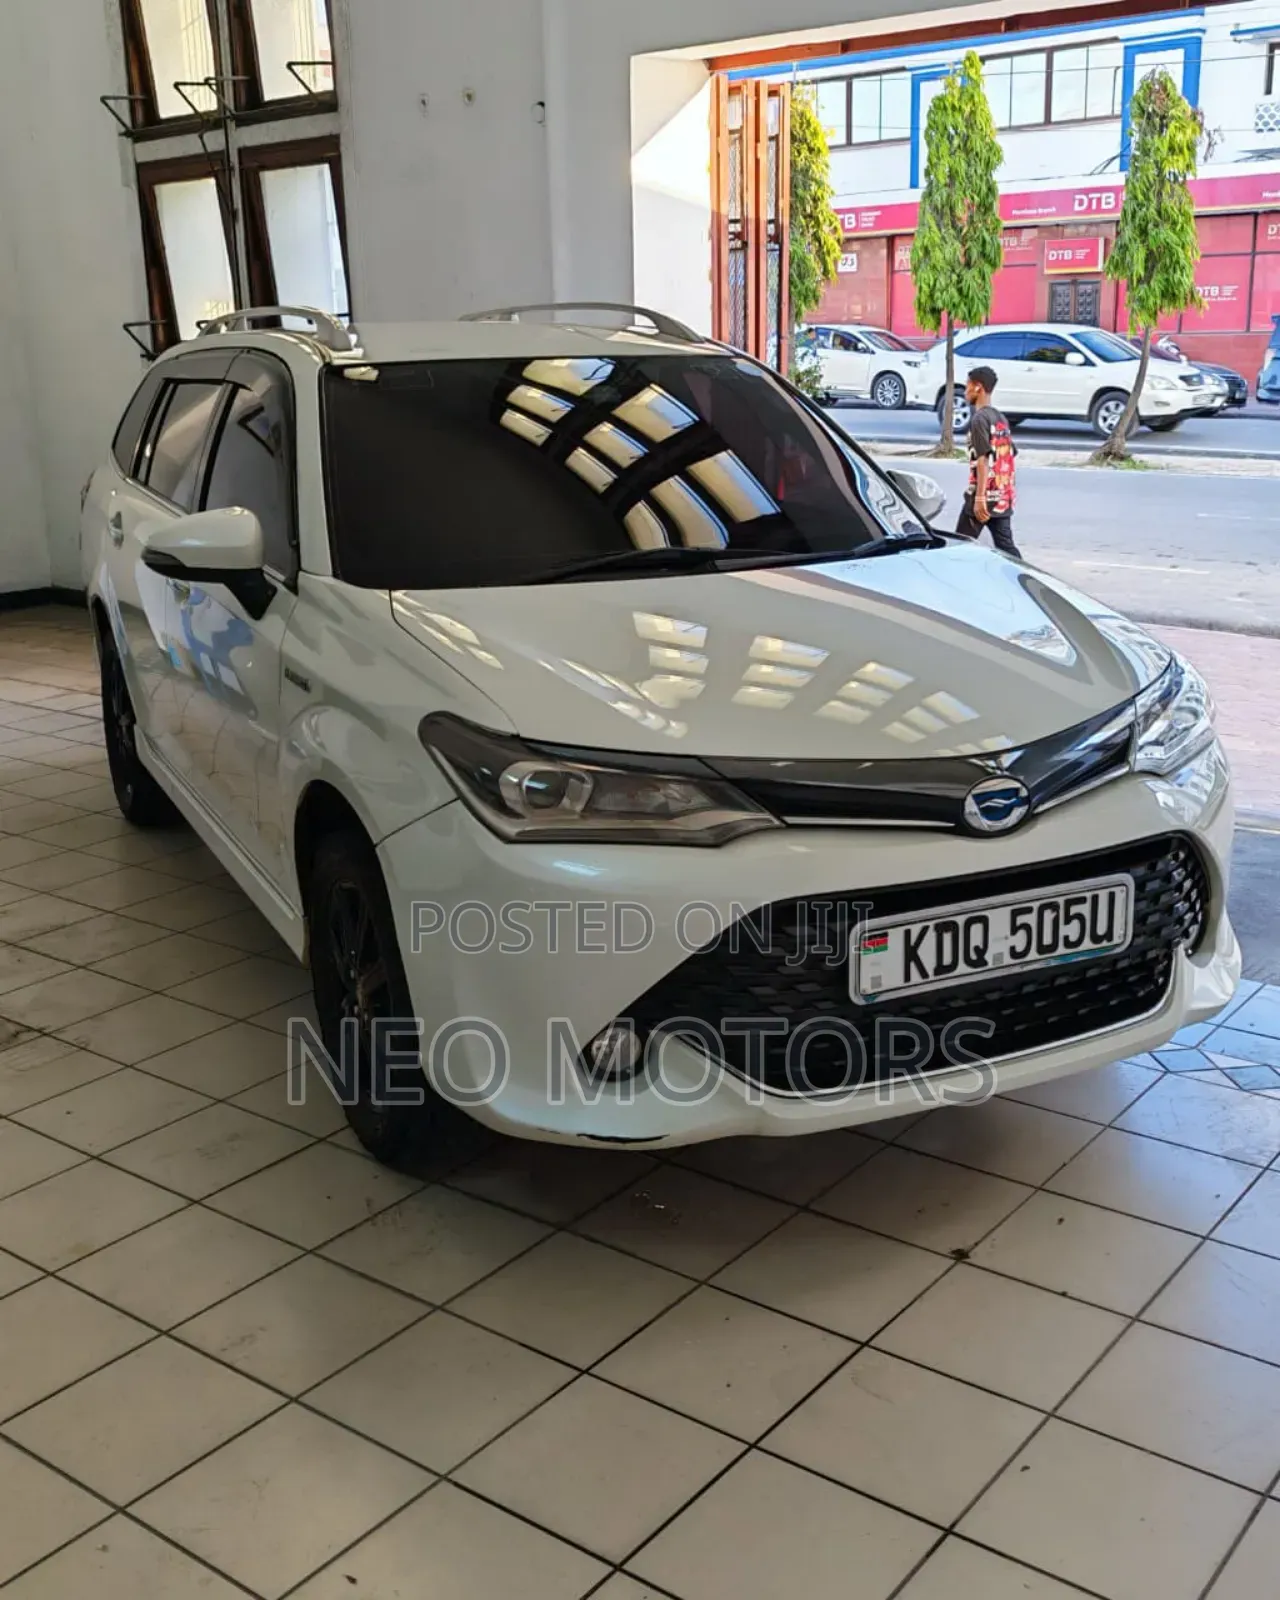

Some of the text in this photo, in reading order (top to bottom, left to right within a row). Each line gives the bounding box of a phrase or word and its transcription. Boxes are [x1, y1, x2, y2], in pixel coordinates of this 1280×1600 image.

[1074, 192, 1115, 211] DTB
[1048, 249, 1073, 261] DTB
[903, 890, 1116, 983] KDQ 505U
